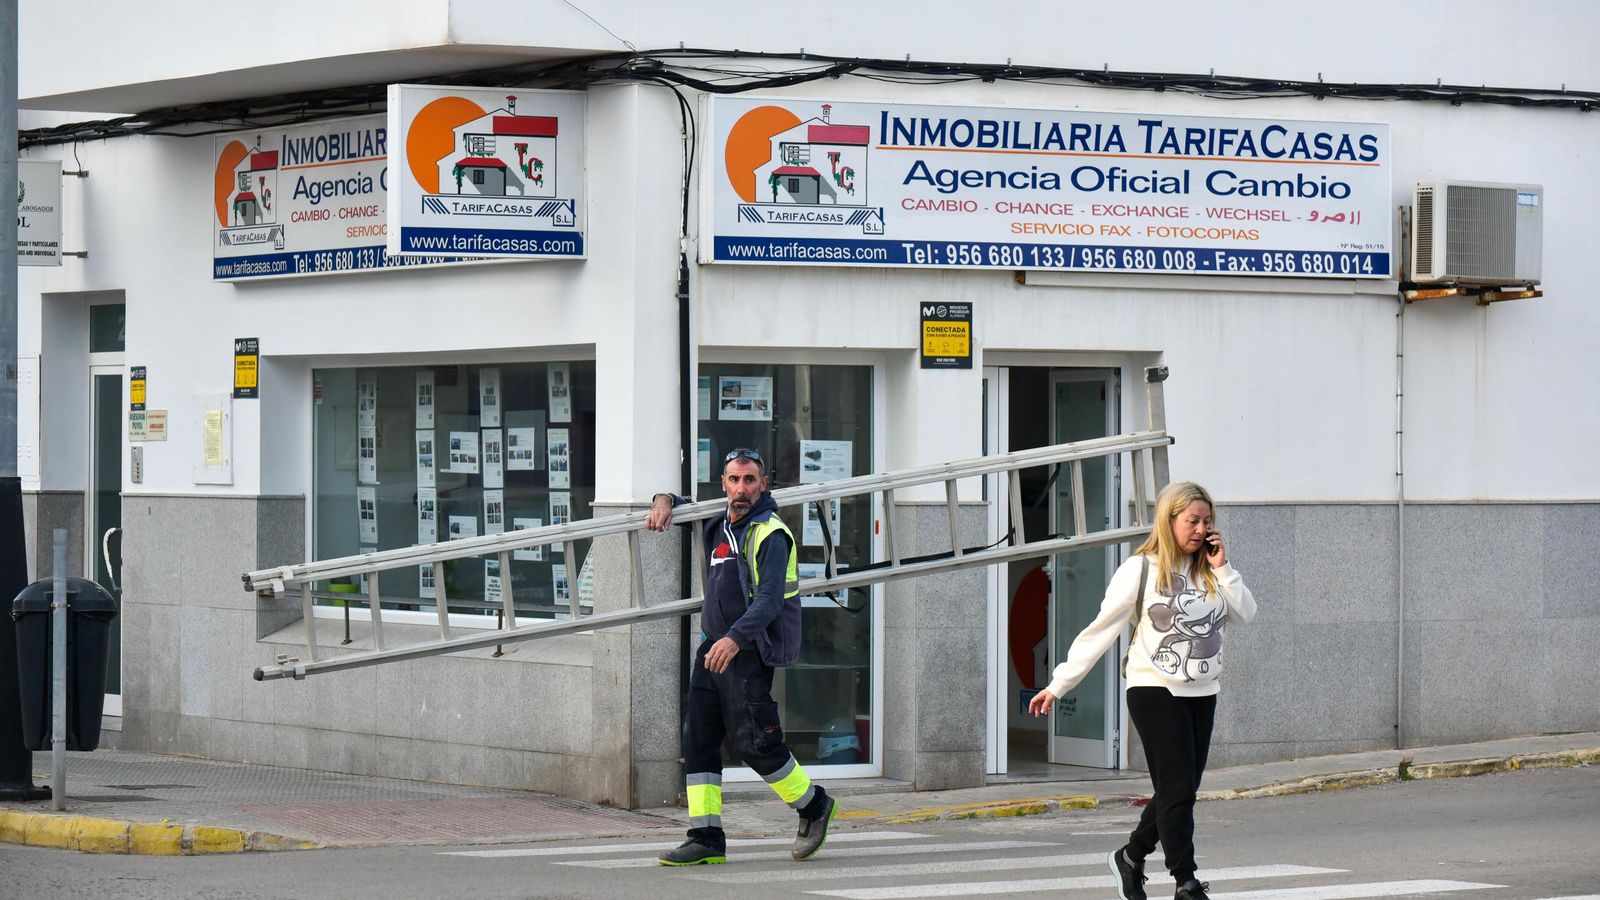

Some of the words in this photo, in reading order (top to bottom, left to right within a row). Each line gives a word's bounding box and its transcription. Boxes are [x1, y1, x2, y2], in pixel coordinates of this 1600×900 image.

[880, 110, 1127, 154] INMOBILIARIA
[293, 172, 374, 205] Agencia
[902, 159, 1061, 194] Agencia
[1070, 165, 1190, 195] Oficial
[1205, 169, 1352, 200] Cambio
[291, 208, 331, 223] CAMBIO
[338, 205, 379, 220] CHANGE
[555, 214, 573, 224] S.L.
[901, 197, 978, 213] CAMBIO
[995, 200, 1074, 216] CHANGE
[1091, 203, 1189, 220] EXCHANGE
[1205, 206, 1291, 223] WECHSEL
[865, 223, 882, 232] S.L.
[1010, 222, 1094, 237] SERVICIO
[1100, 225, 1132, 237] FAX
[1147, 226, 1260, 241] FOTOCOPIAS
[409, 234, 576, 254] www.tarifacasas.com
[727, 241, 887, 260] www.tarifacasas.com
[215, 260, 288, 277] www.tarifacasas.com
[293, 254, 312, 273] Tel:
[314, 252, 333, 272] 956
[335, 250, 354, 271] 680
[356, 249, 374, 268] 133
[902, 243, 940, 264] Tel:
[947, 244, 982, 265] 956
[988, 245, 1024, 266] 680
[1030, 246, 1065, 267] 133
[1081, 248, 1117, 269] 956
[1122, 248, 1156, 270] 680
[1162, 250, 1197, 271] 008
[1215, 253, 1256, 272] Fax:
[1262, 252, 1296, 273] 956
[1301, 254, 1336, 274] 680
[1340, 254, 1374, 275] 014
